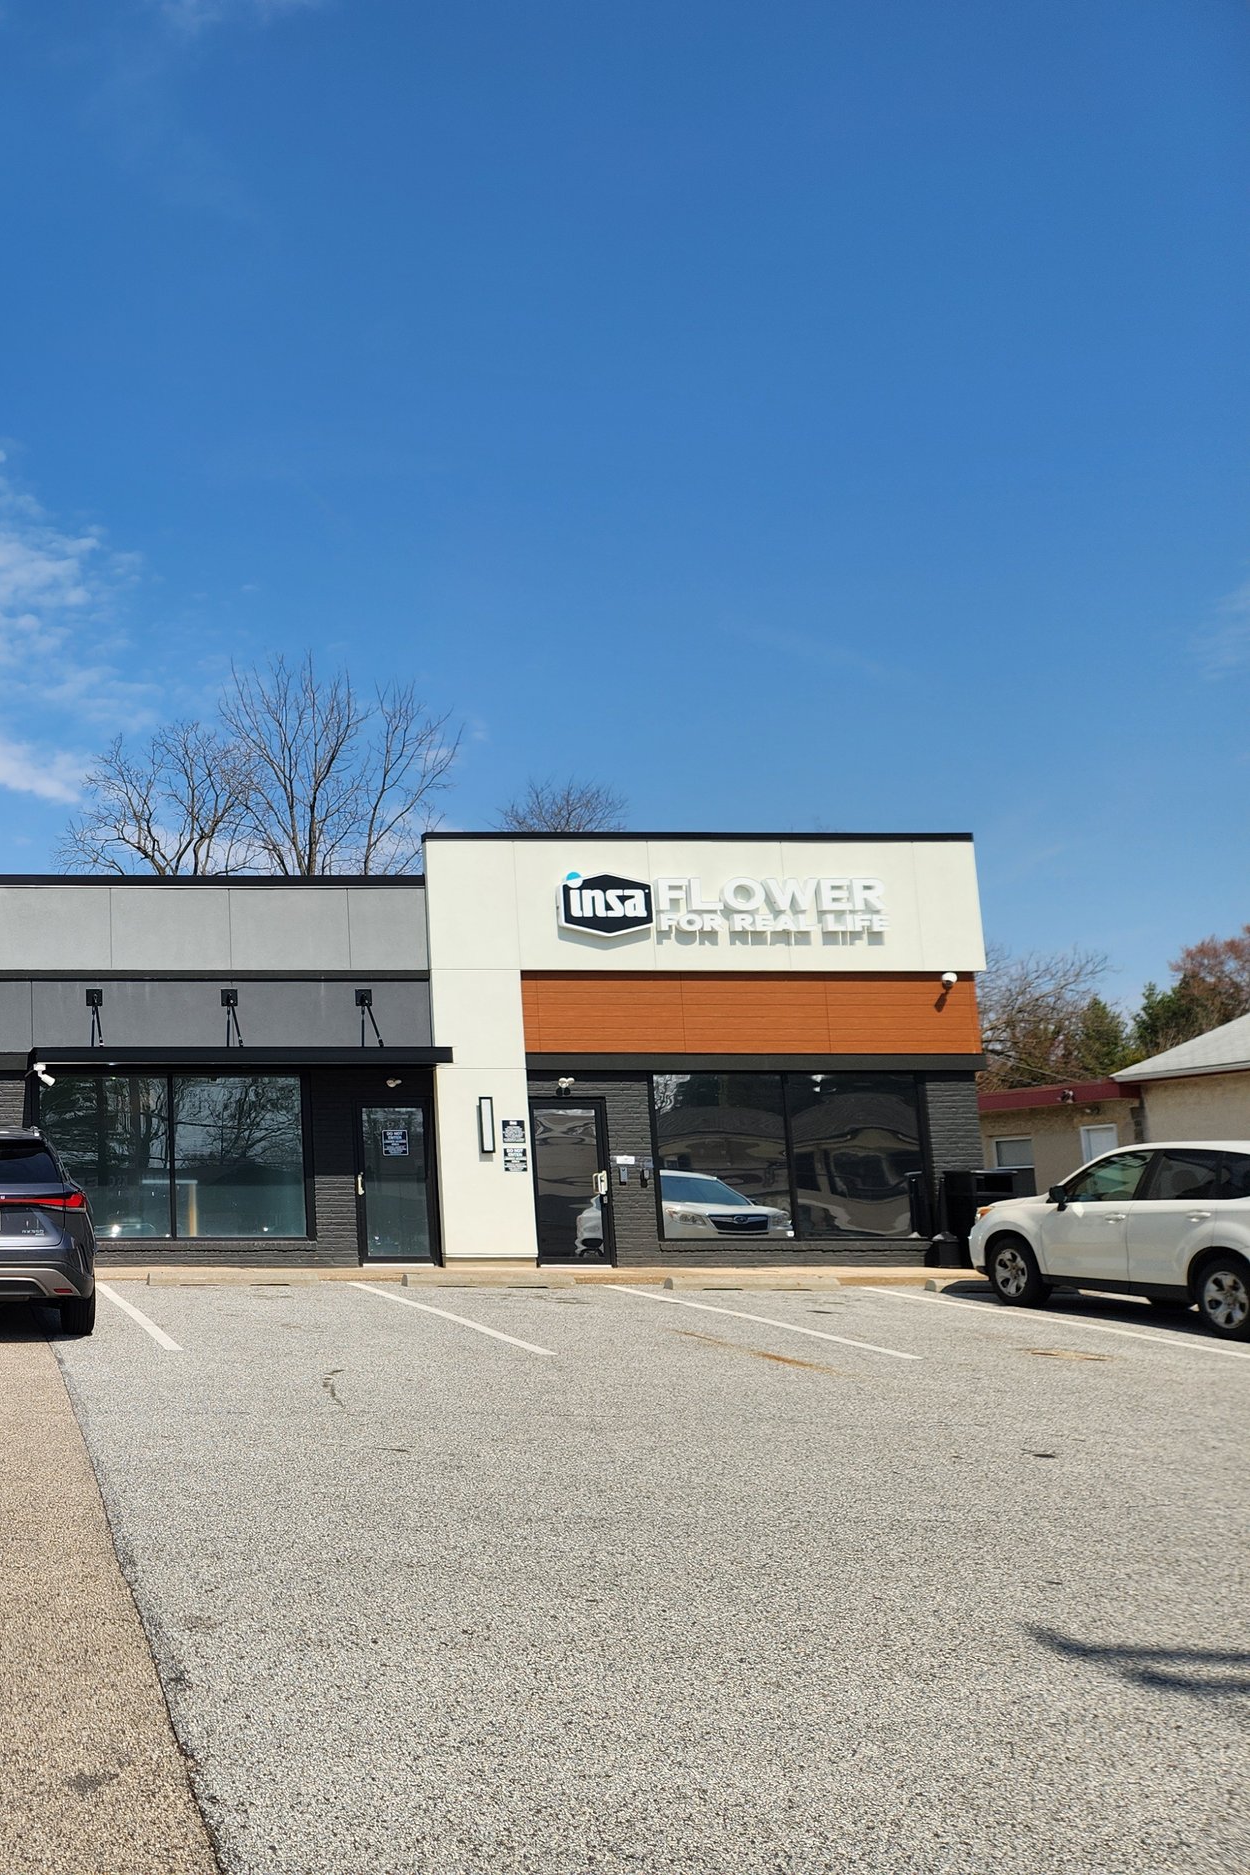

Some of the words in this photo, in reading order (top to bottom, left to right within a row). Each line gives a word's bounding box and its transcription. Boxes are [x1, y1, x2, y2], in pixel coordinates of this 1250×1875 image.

[566, 872, 647, 917] insa
[654, 877, 886, 911] FLOWER
[655, 914, 724, 931] FOR
[728, 914, 817, 931] REAL
[821, 914, 890, 931] LIFE
